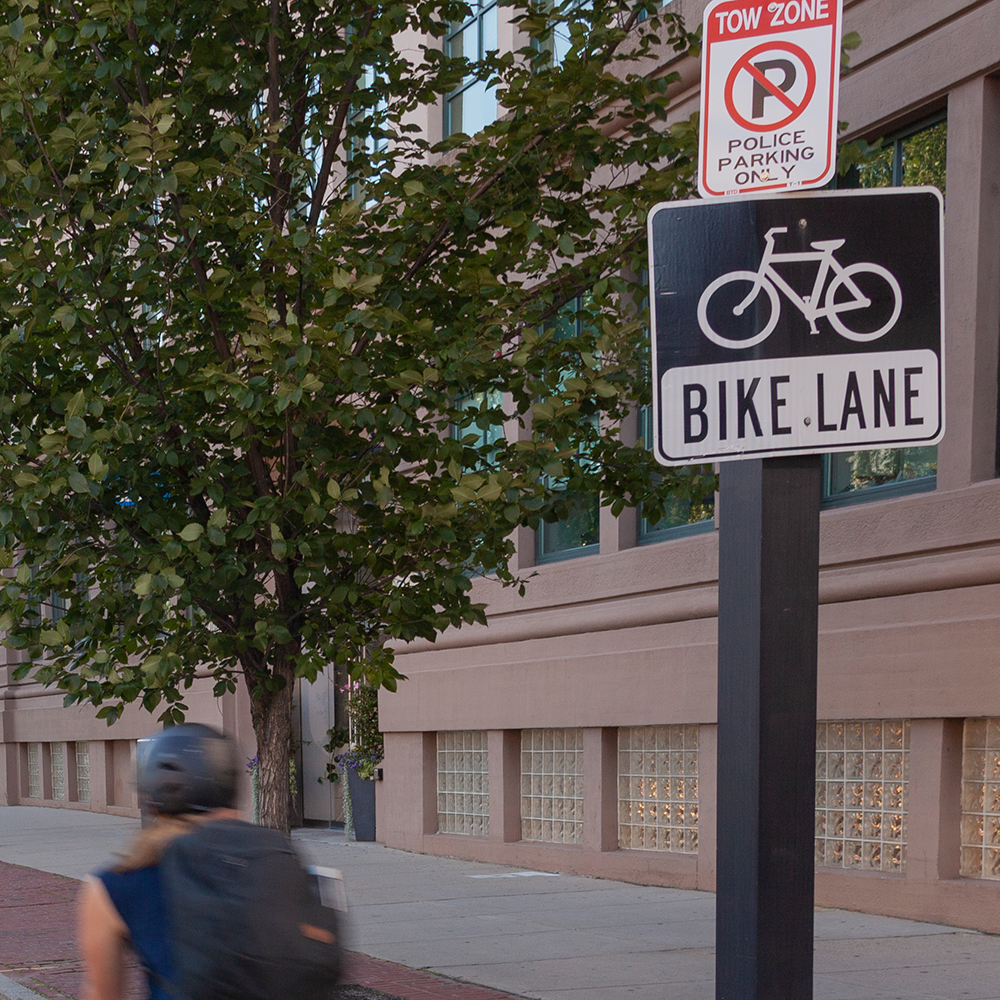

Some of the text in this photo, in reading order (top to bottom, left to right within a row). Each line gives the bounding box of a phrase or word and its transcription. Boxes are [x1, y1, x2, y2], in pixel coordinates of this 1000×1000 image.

[715, 0, 829, 35] TOW ZONE
[728, 130, 806, 153] POLICE
[718, 146, 814, 172] PARKING
[735, 165, 797, 185] ONLY
[683, 367, 924, 444] BIKE LANE
